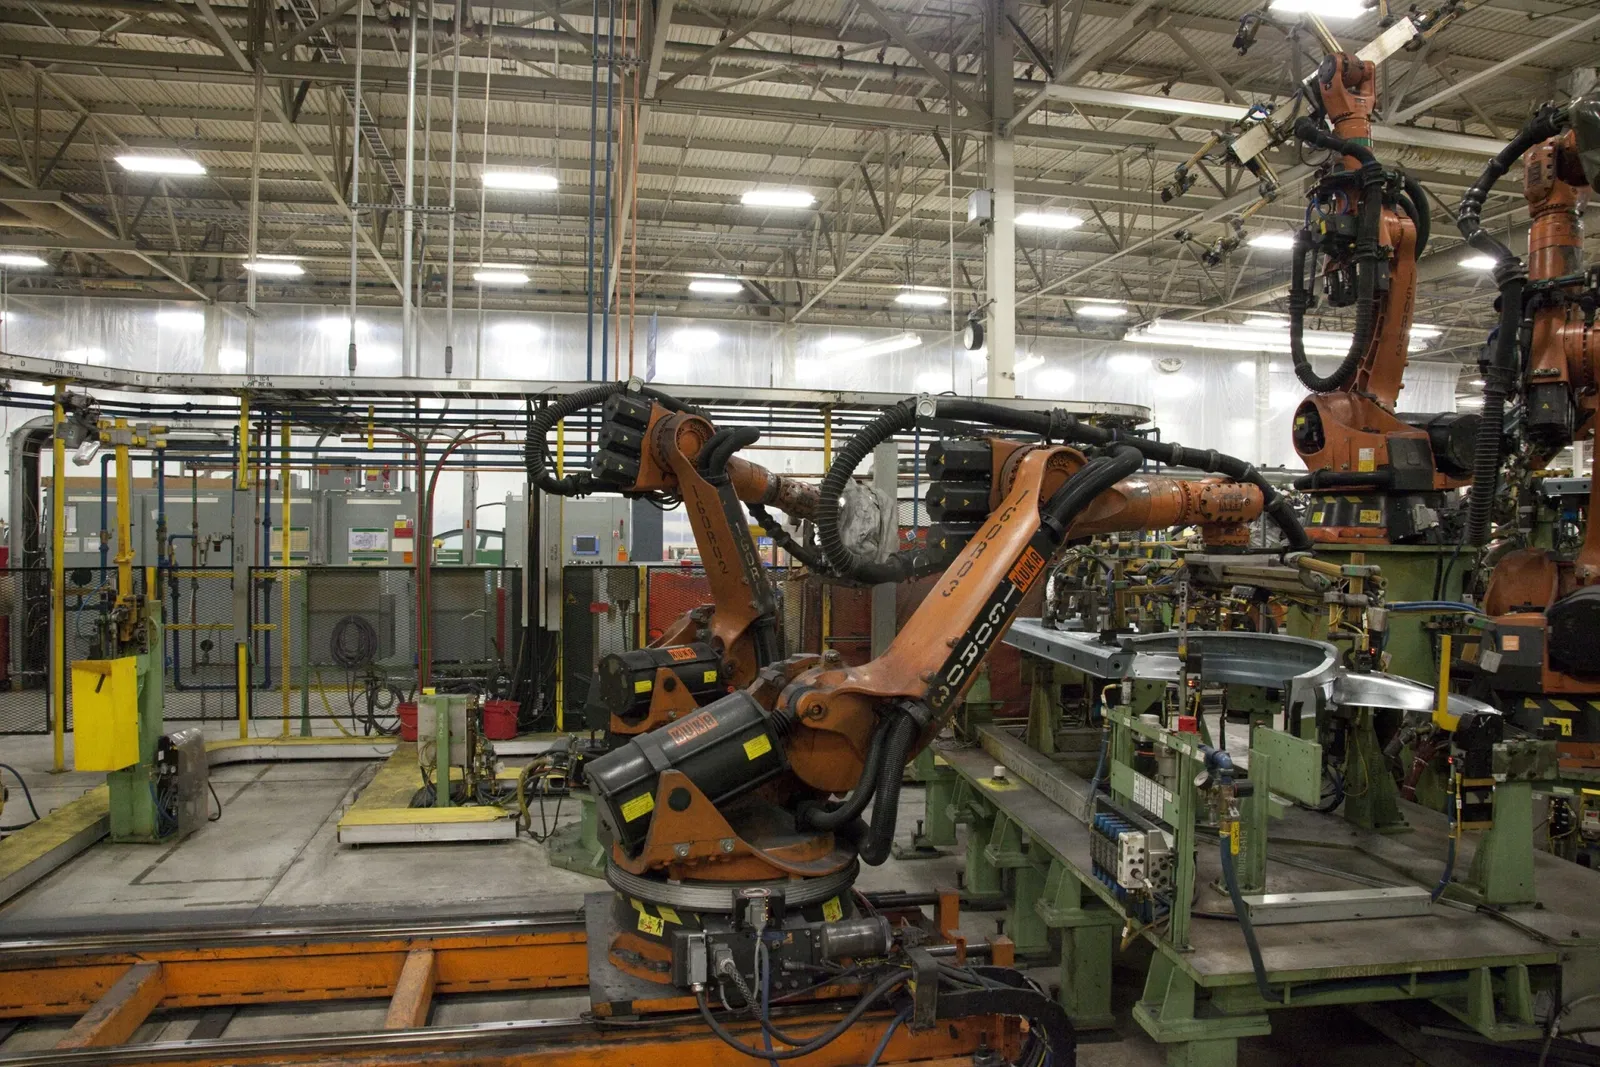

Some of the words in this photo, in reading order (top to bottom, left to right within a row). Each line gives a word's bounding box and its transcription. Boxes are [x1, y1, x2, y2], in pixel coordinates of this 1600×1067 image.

[942, 490, 1030, 597] 160R03
[1013, 549, 1043, 590] KUKA
[670, 649, 695, 659] KUKA
[931, 584, 1017, 707] 160R03
[670, 713, 715, 741] KUKA
